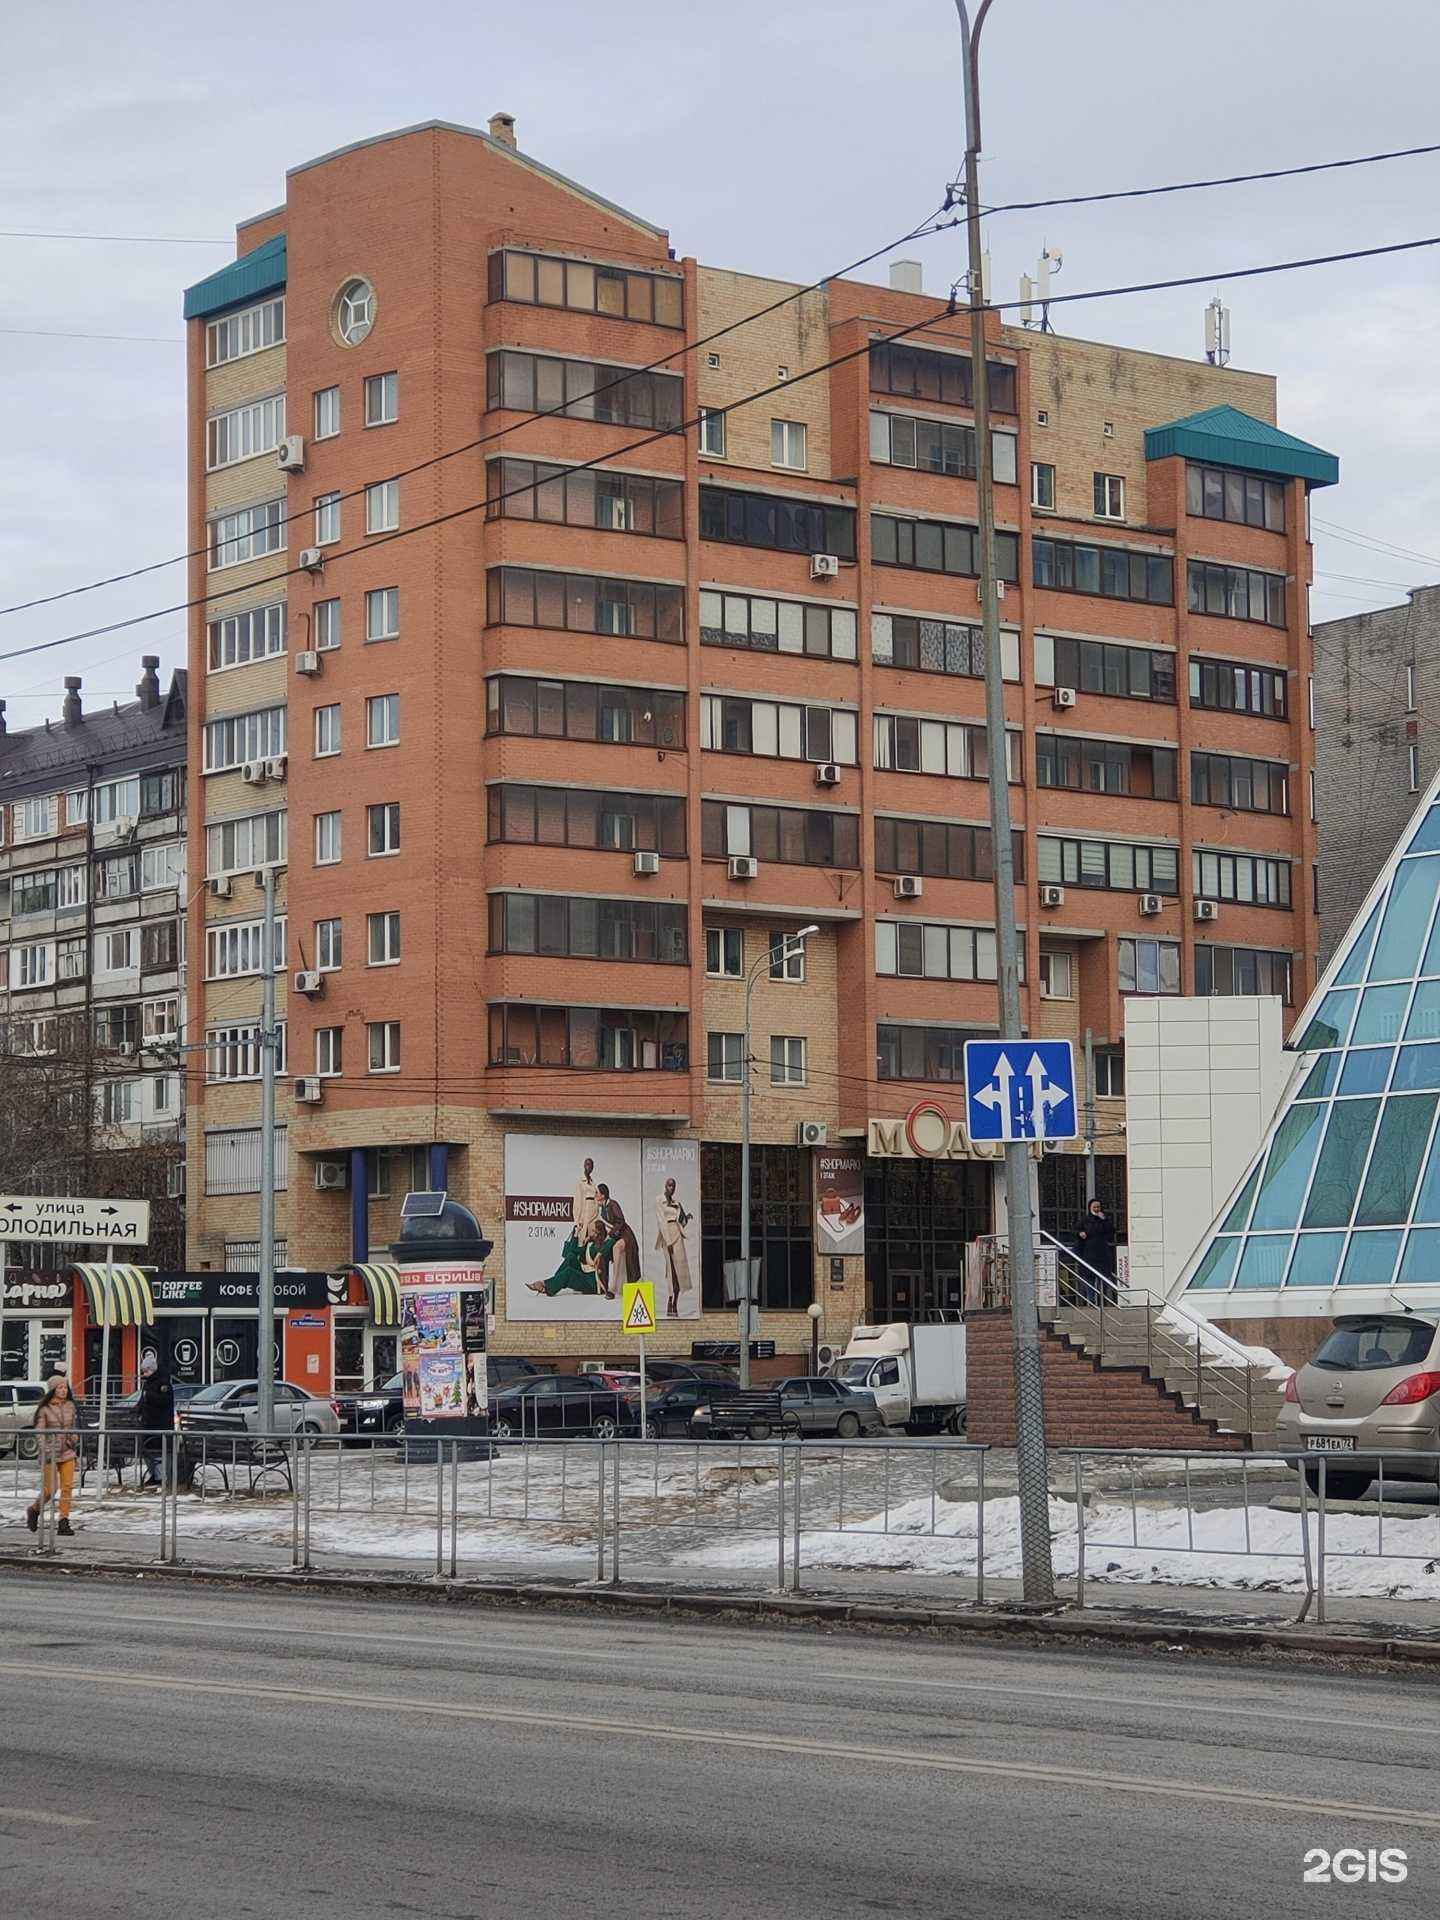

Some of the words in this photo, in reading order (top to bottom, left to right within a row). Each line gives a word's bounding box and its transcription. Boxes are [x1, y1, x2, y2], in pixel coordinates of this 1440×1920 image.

[36, 1203, 84, 1216] улица
[513, 1200, 570, 1217] #SHOPMARKI
[534, 1226, 556, 1238] ЭТАЖ
[162, 1281, 202, 1291] COFFEE
[219, 1284, 252, 1296] КОФЕ
[273, 1282, 306, 1297] ОБОЙ
[162, 1290, 186, 1300] LIKE
